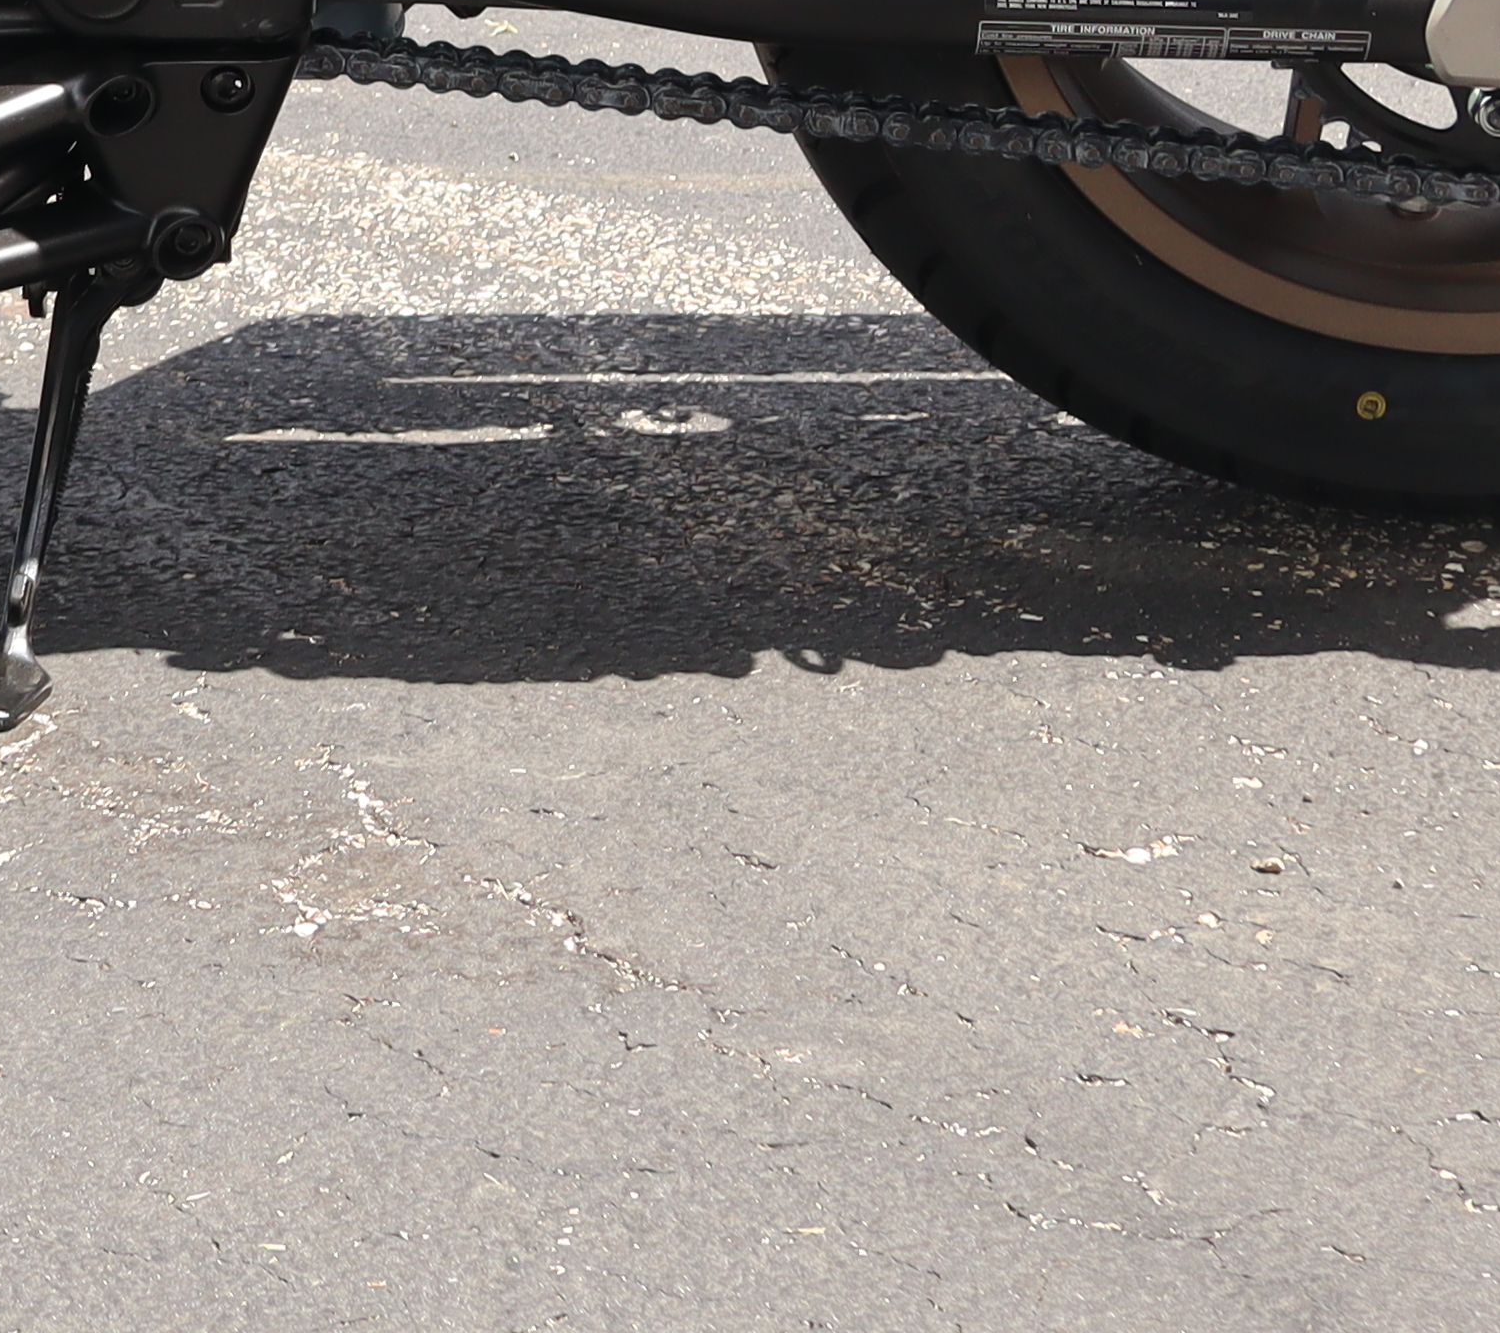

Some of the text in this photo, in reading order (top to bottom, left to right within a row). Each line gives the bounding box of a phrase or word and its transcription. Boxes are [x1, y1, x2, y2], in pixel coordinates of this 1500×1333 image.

[1050, 24, 1156, 36] TIRE INFORMATION
[1262, 30, 1337, 41] DRIVE CHAIN
